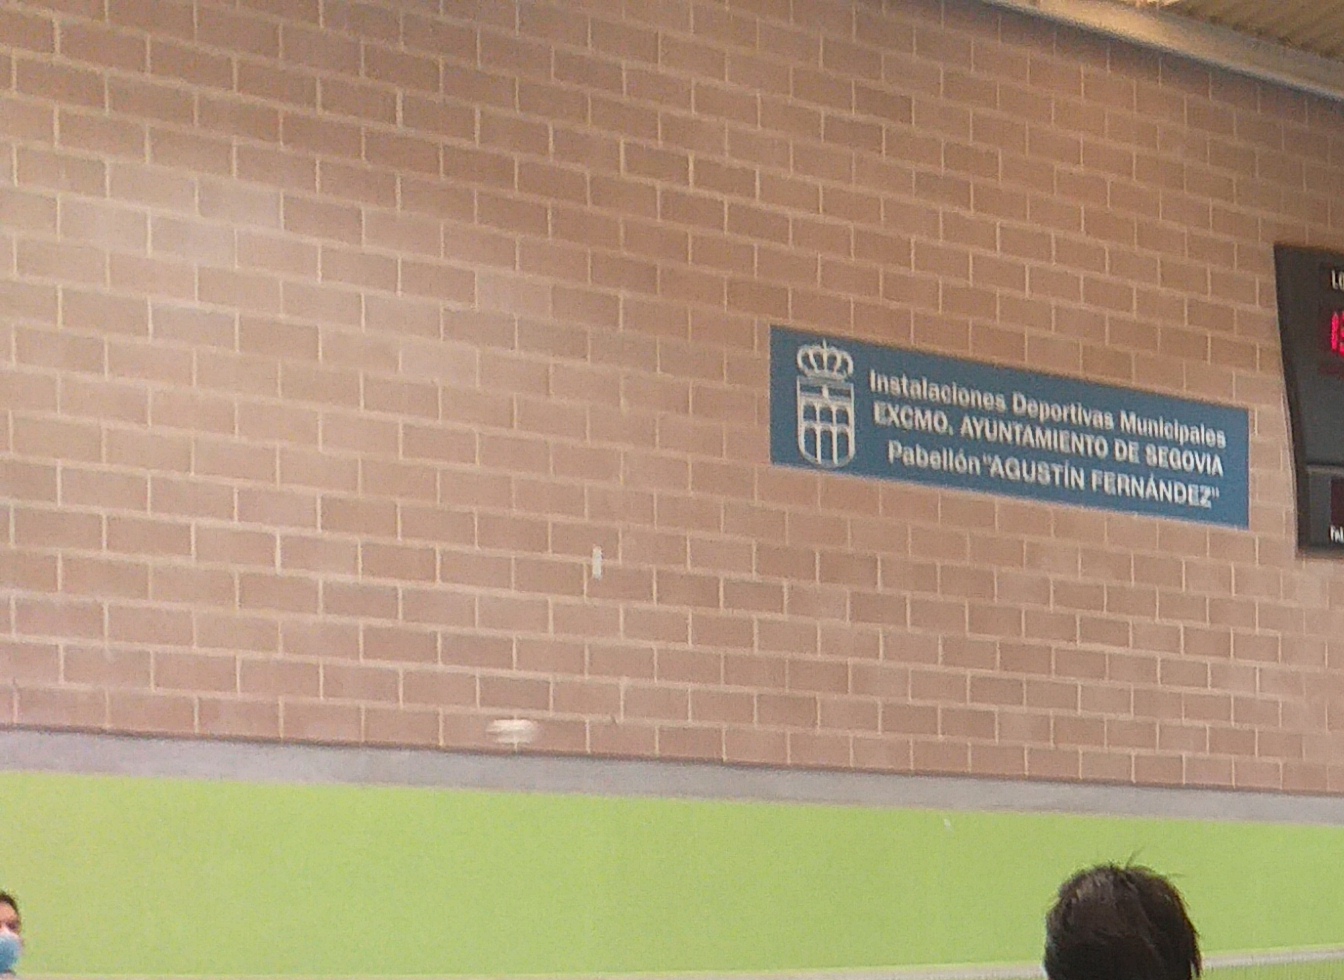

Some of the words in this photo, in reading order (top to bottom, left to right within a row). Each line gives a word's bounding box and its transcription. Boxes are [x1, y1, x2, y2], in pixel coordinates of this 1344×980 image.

[869, 369, 1006, 413] Instalaciones
[1012, 390, 1114, 430] Deportivas
[1120, 410, 1227, 449] Municipales
[873, 401, 954, 436] EXCMO.
[960, 414, 1109, 460] AYUNTAMIENTO
[1115, 438, 1140, 464] DE
[1145, 443, 1224, 477] SEGOVIA
[888, 439, 981, 476] Pabellón
